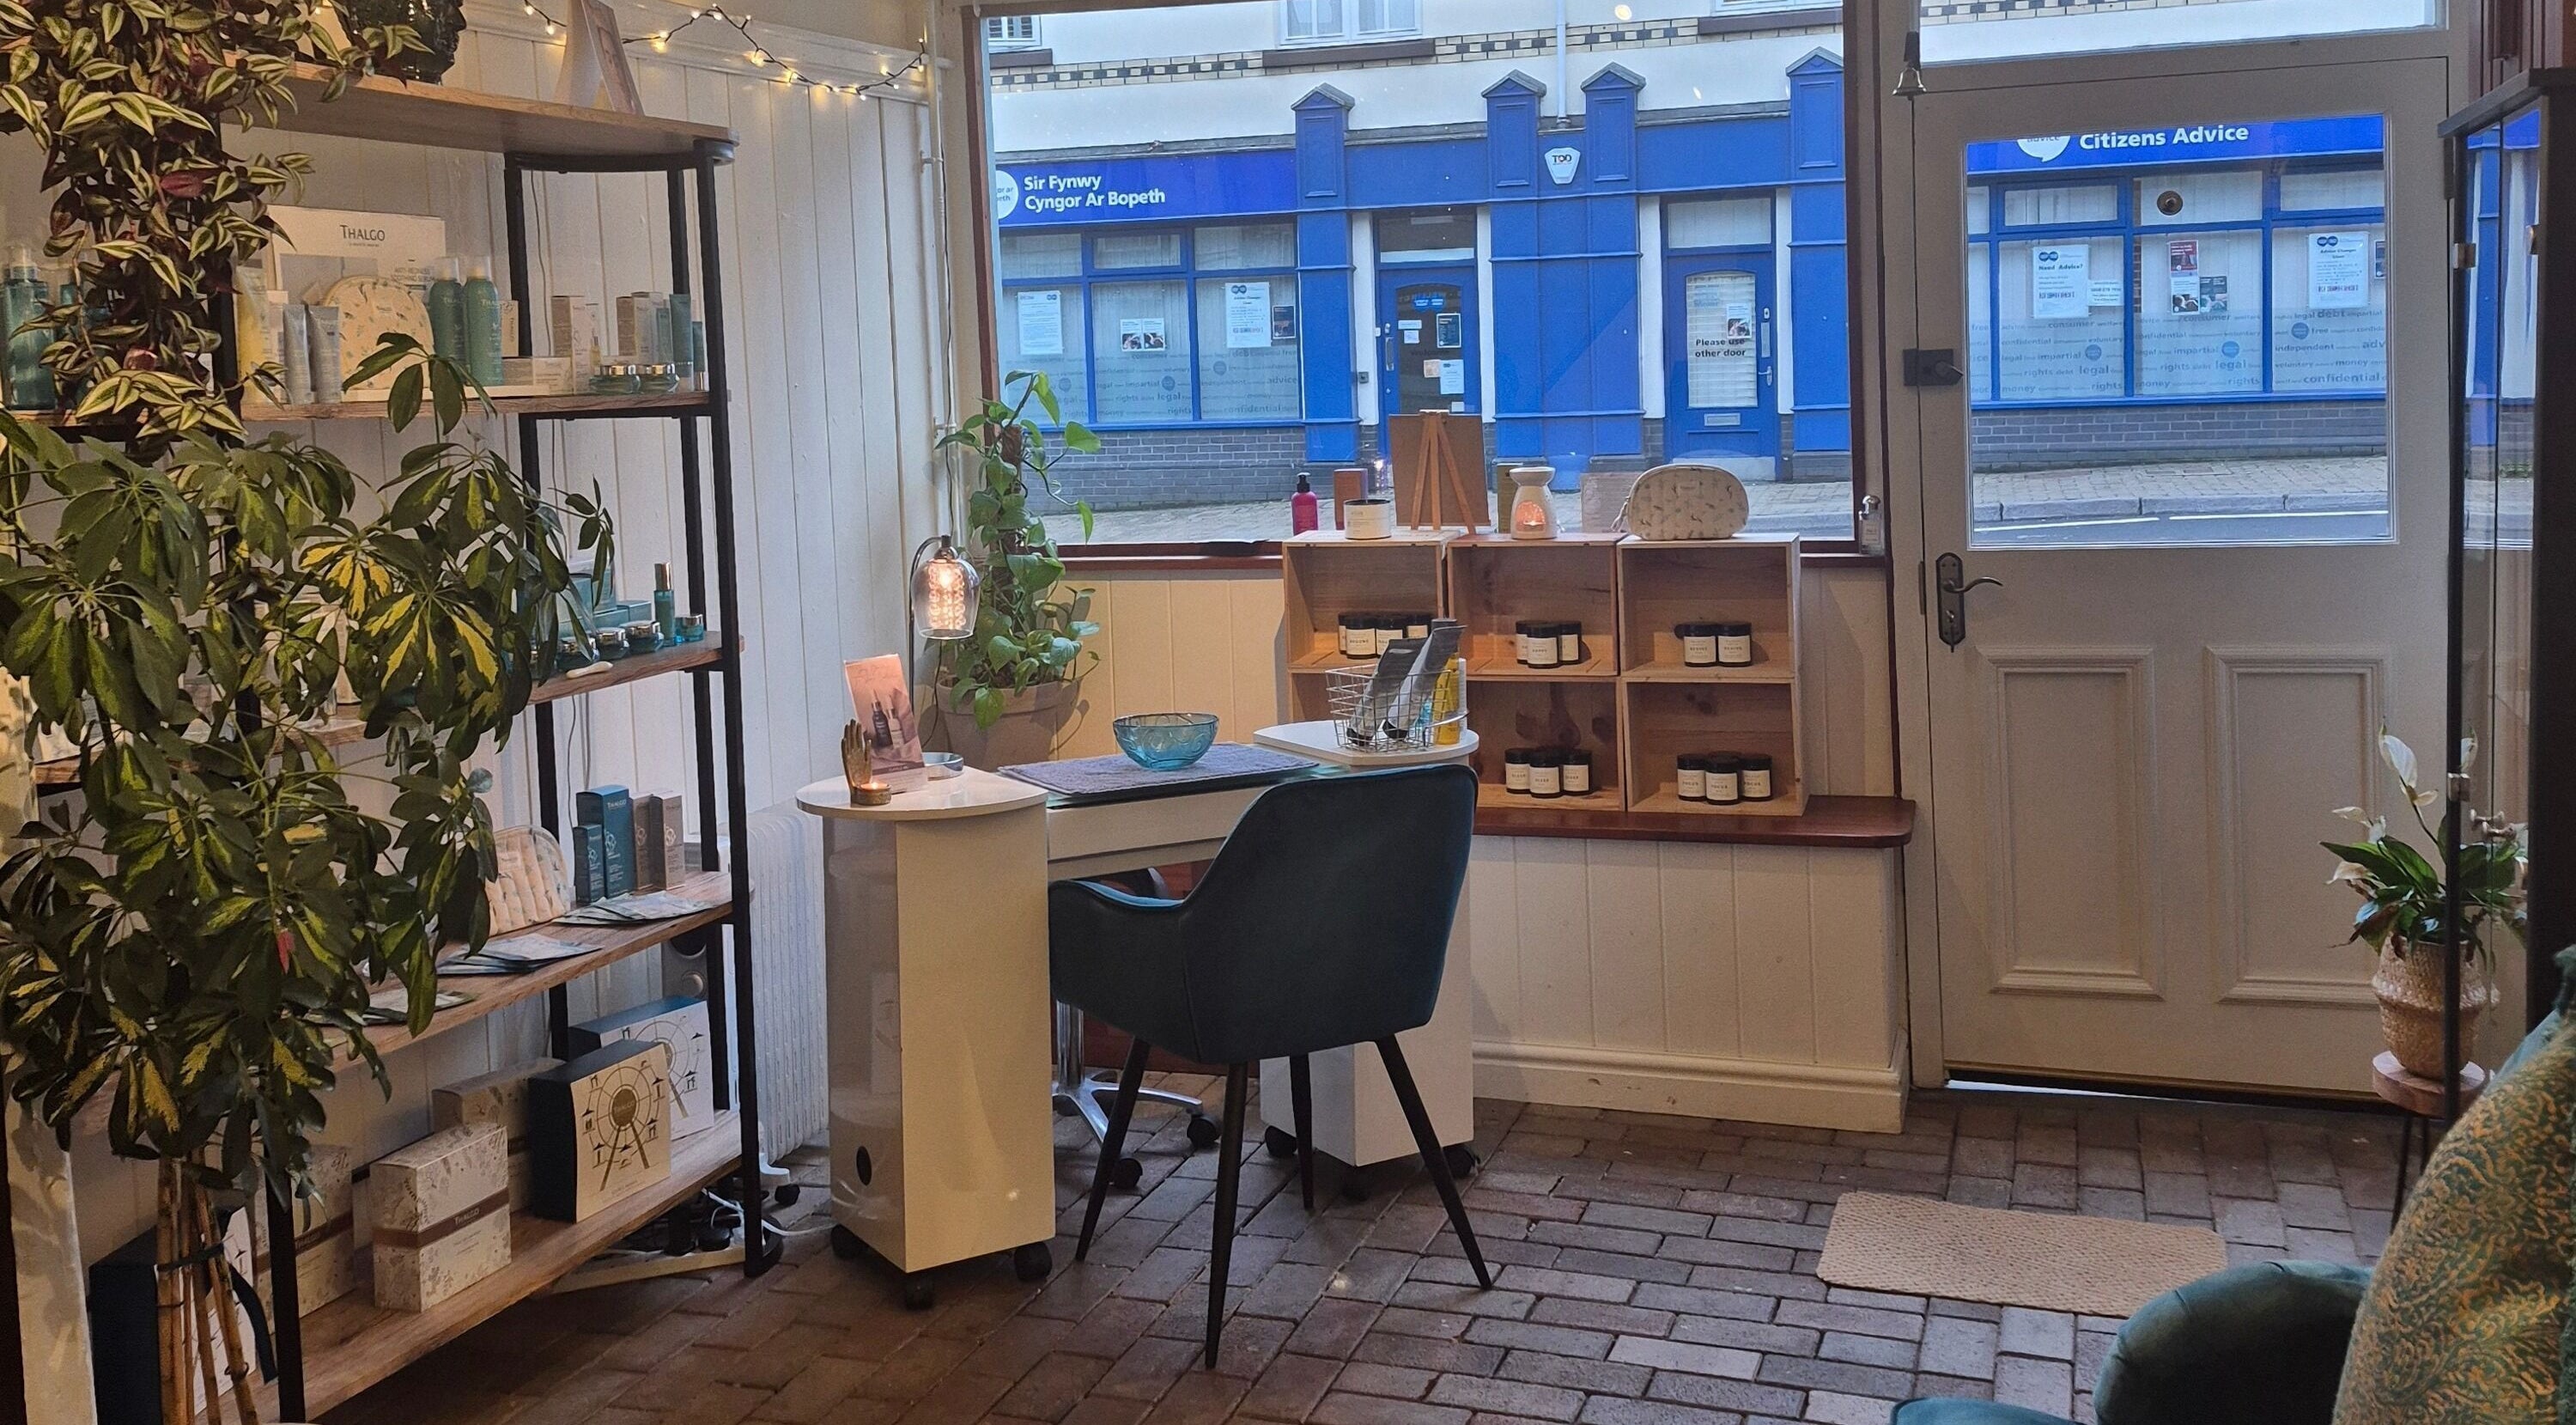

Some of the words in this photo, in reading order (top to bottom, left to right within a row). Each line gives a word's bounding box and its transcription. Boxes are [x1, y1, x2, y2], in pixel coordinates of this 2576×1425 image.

[2079, 131, 2166, 150] Citizens
[2172, 124, 2249, 145] Advice
[1024, 174, 1046, 192] Sir
[1048, 174, 1102, 192] Fynwy
[1024, 194, 1082, 213] Cyngor
[1085, 192, 1104, 207] Ar
[1108, 187, 1165, 209] Bopeth
[339, 224, 386, 241] THALGO
[1695, 350, 1720, 358] other
[2275, 343, 2335, 352] independent
[2037, 351, 2081, 362] impartial
[2079, 364, 2109, 377] legal
[2215, 359, 2246, 372] legal
[2302, 372, 2380, 384] confidential
[454, 1208, 481, 1227] THALGO
